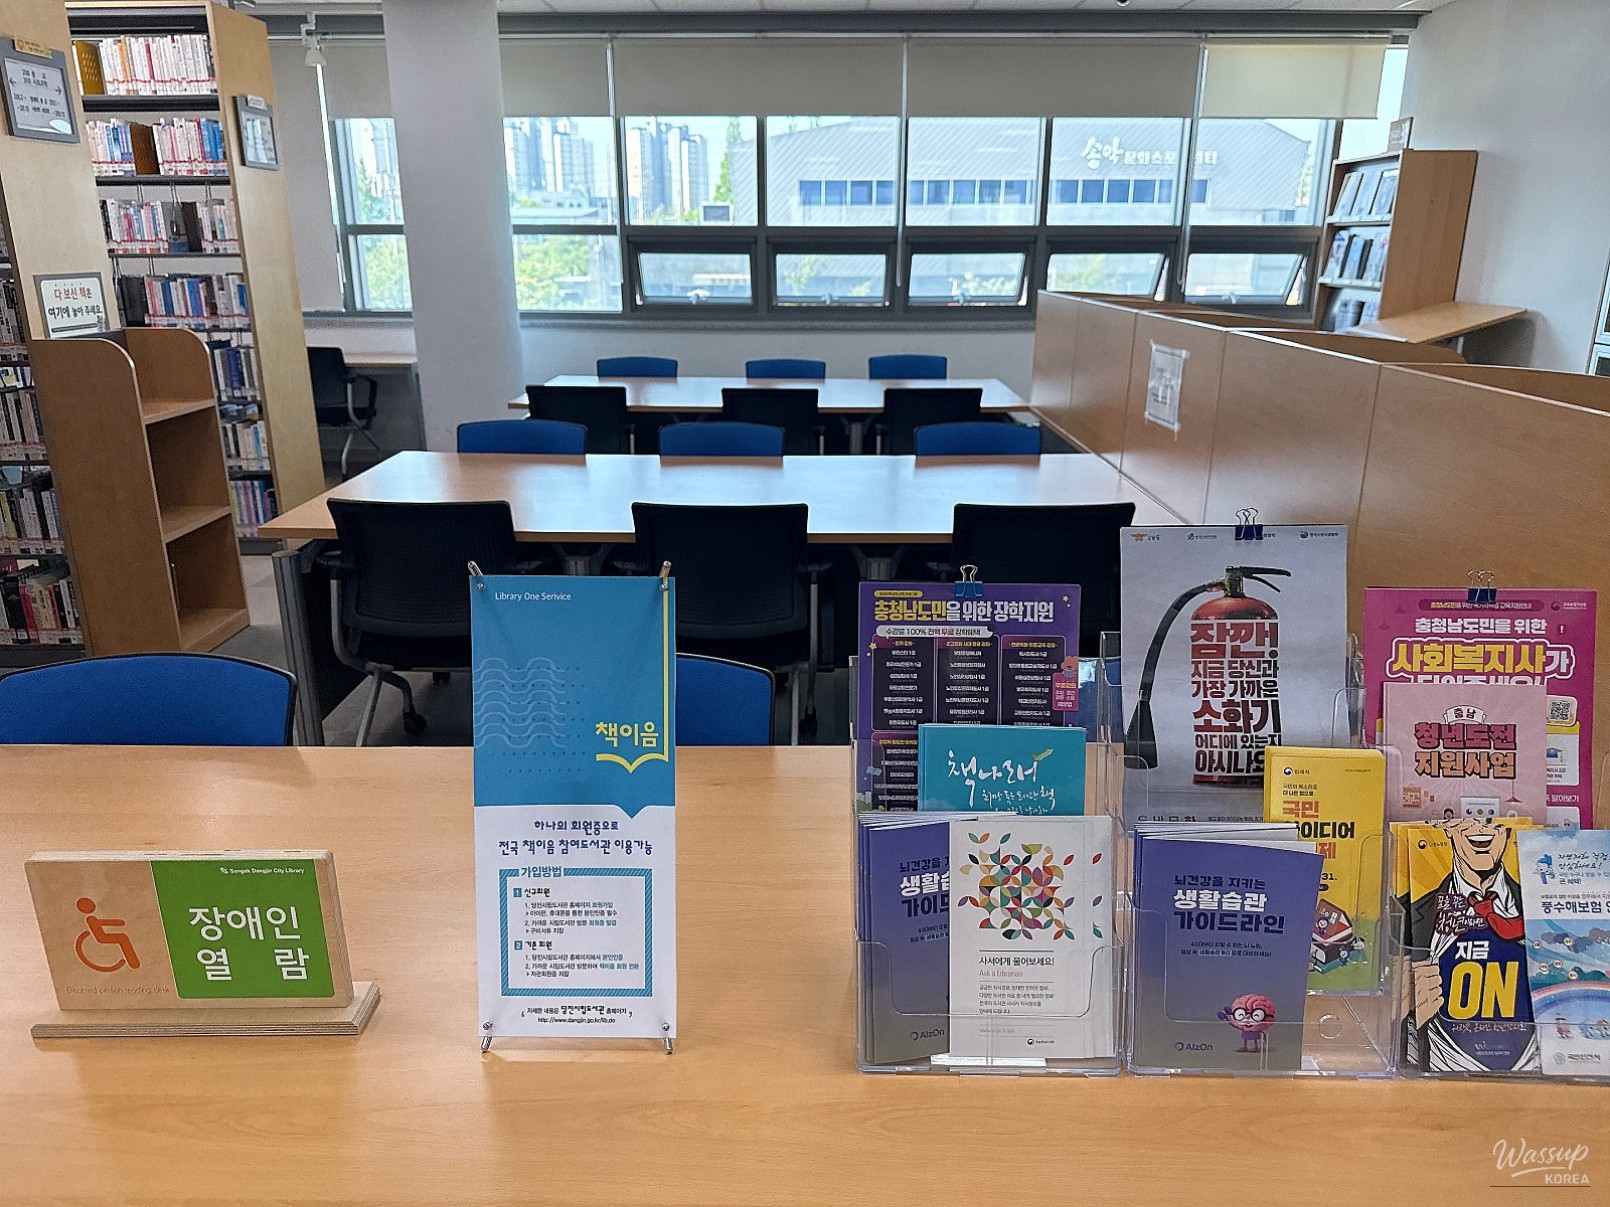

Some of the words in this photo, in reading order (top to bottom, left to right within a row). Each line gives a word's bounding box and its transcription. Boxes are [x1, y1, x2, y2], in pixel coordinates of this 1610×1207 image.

[54, 288, 61, 300] 다
[64, 287, 78, 300] 보신
[79, 287, 92, 299] 책은
[48, 306, 70, 319] 여기에
[72, 306, 84, 317] 놓아
[85, 305, 103, 315] 주세요
[495, 592, 522, 601] Library
[524, 592, 539, 600] One
[541, 592, 571, 600] Serivice
[874, 600, 960, 622] 충청남도민을
[963, 601, 992, 622] 위한
[994, 601, 1054, 622] 장학지원
[1415, 618, 1511, 634] 충청남도민을
[1514, 618, 1547, 634] 위한
[1191, 623, 1278, 659] 잠깐!
[1392, 643, 1570, 673] 사회복지사가
[1191, 660, 1224, 678] 지금
[1228, 660, 1279, 679] 당신과
[1191, 681, 1225, 698] 가장
[1229, 680, 1279, 698] 가까운
[1192, 699, 1282, 733] 소화기
[1454, 708, 1477, 718] 충남
[595, 721, 659, 747] 책이음
[1195, 735, 1237, 749] 어디에
[1240, 734, 1282, 748] 있는지
[1414, 722, 1516, 750] 청년도전
[1415, 751, 1516, 779] 지원사업
[1283, 801, 1319, 818] 국민
[534, 820, 567, 830] 하나의
[571, 820, 618, 836] 회원증으로
[1286, 821, 1355, 838] 이디어
[499, 840, 518, 855] 전국
[522, 839, 555, 855] 책이음
[559, 839, 611, 855] 참여도서관
[614, 840, 653, 855] 이용가능
[521, 866, 562, 877] 가입방법
[899, 857, 940, 872] 뇌건강을
[1174, 875, 1224, 887] 뇌건강을
[1228, 877, 1266, 890] 지키는
[524, 888, 550, 897] 신규회원
[1173, 889, 1267, 912] 생활습관
[1541, 901, 1601, 914] 풍수해보험
[189, 906, 300, 941] 장애인
[1174, 911, 1285, 934] 가이드라인
[539, 941, 552, 950] 회원
[1455, 940, 1490, 960] 지금
[197, 948, 232, 981] 열
[274, 948, 310, 980] 람
[979, 956, 1011, 966] 사서에게
[1013, 957, 1054, 966] 물어보세요!
[1448, 961, 1519, 1019] ON
[920, 1028, 945, 1040] AlzOn
[1185, 1043, 1213, 1051] AlzOn
